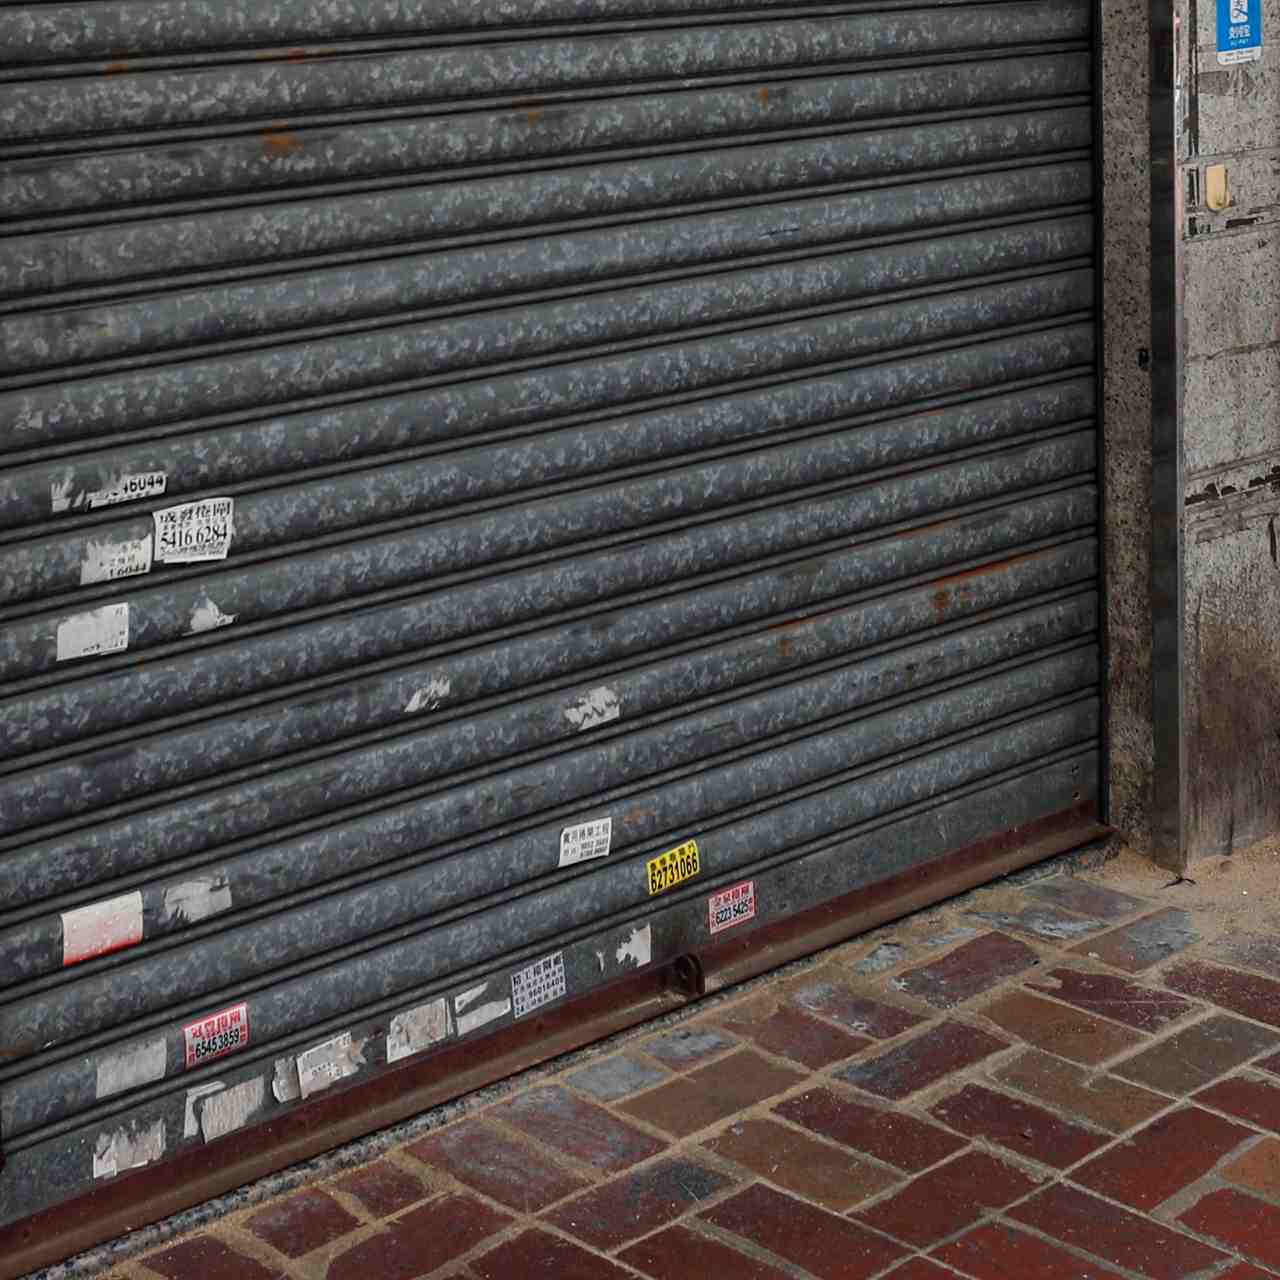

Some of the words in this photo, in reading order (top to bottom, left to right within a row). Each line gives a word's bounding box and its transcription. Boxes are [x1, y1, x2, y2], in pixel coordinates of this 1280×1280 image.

[161, 528, 193, 548] 5416
[195, 523, 228, 544] 6284
[650, 852, 698, 893] 62731066
